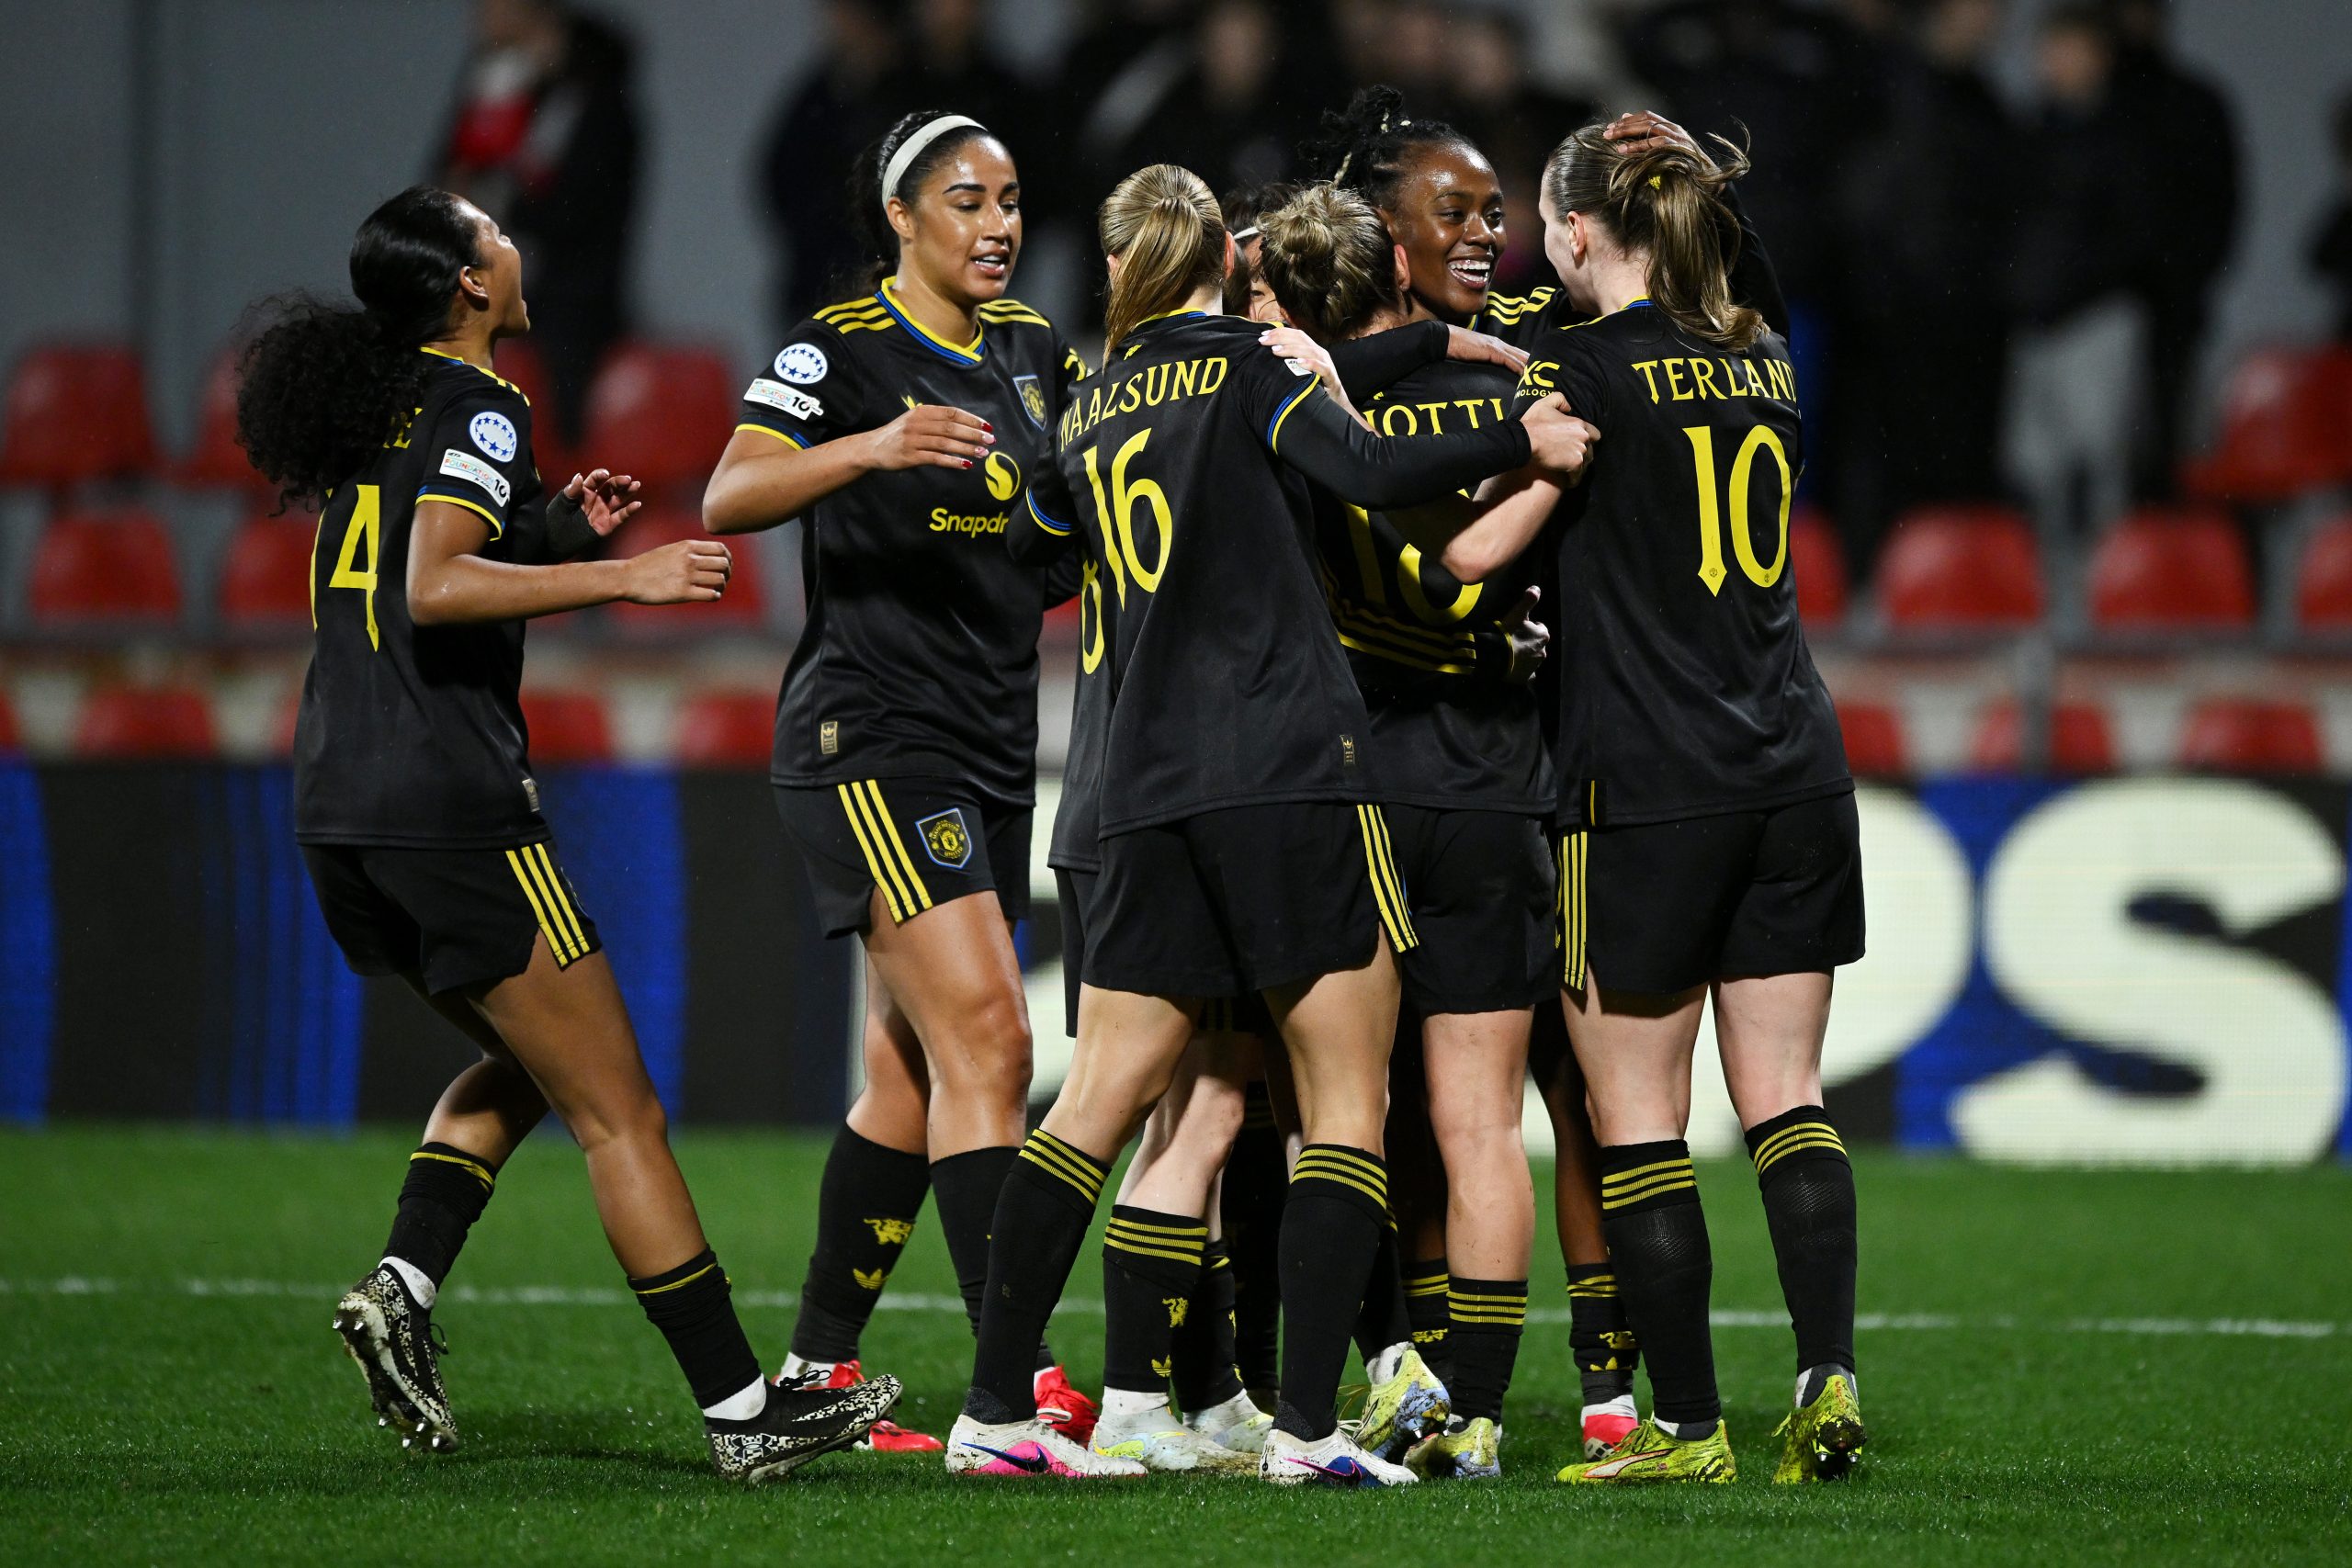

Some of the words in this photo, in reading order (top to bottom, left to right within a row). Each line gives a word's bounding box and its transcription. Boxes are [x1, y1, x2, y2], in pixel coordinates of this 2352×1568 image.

[1060, 357, 1228, 453] NAALSUND
[1631, 357, 1797, 405] TERLAND
[1082, 427, 1172, 612] 16
[1681, 424, 1792, 598] 10
